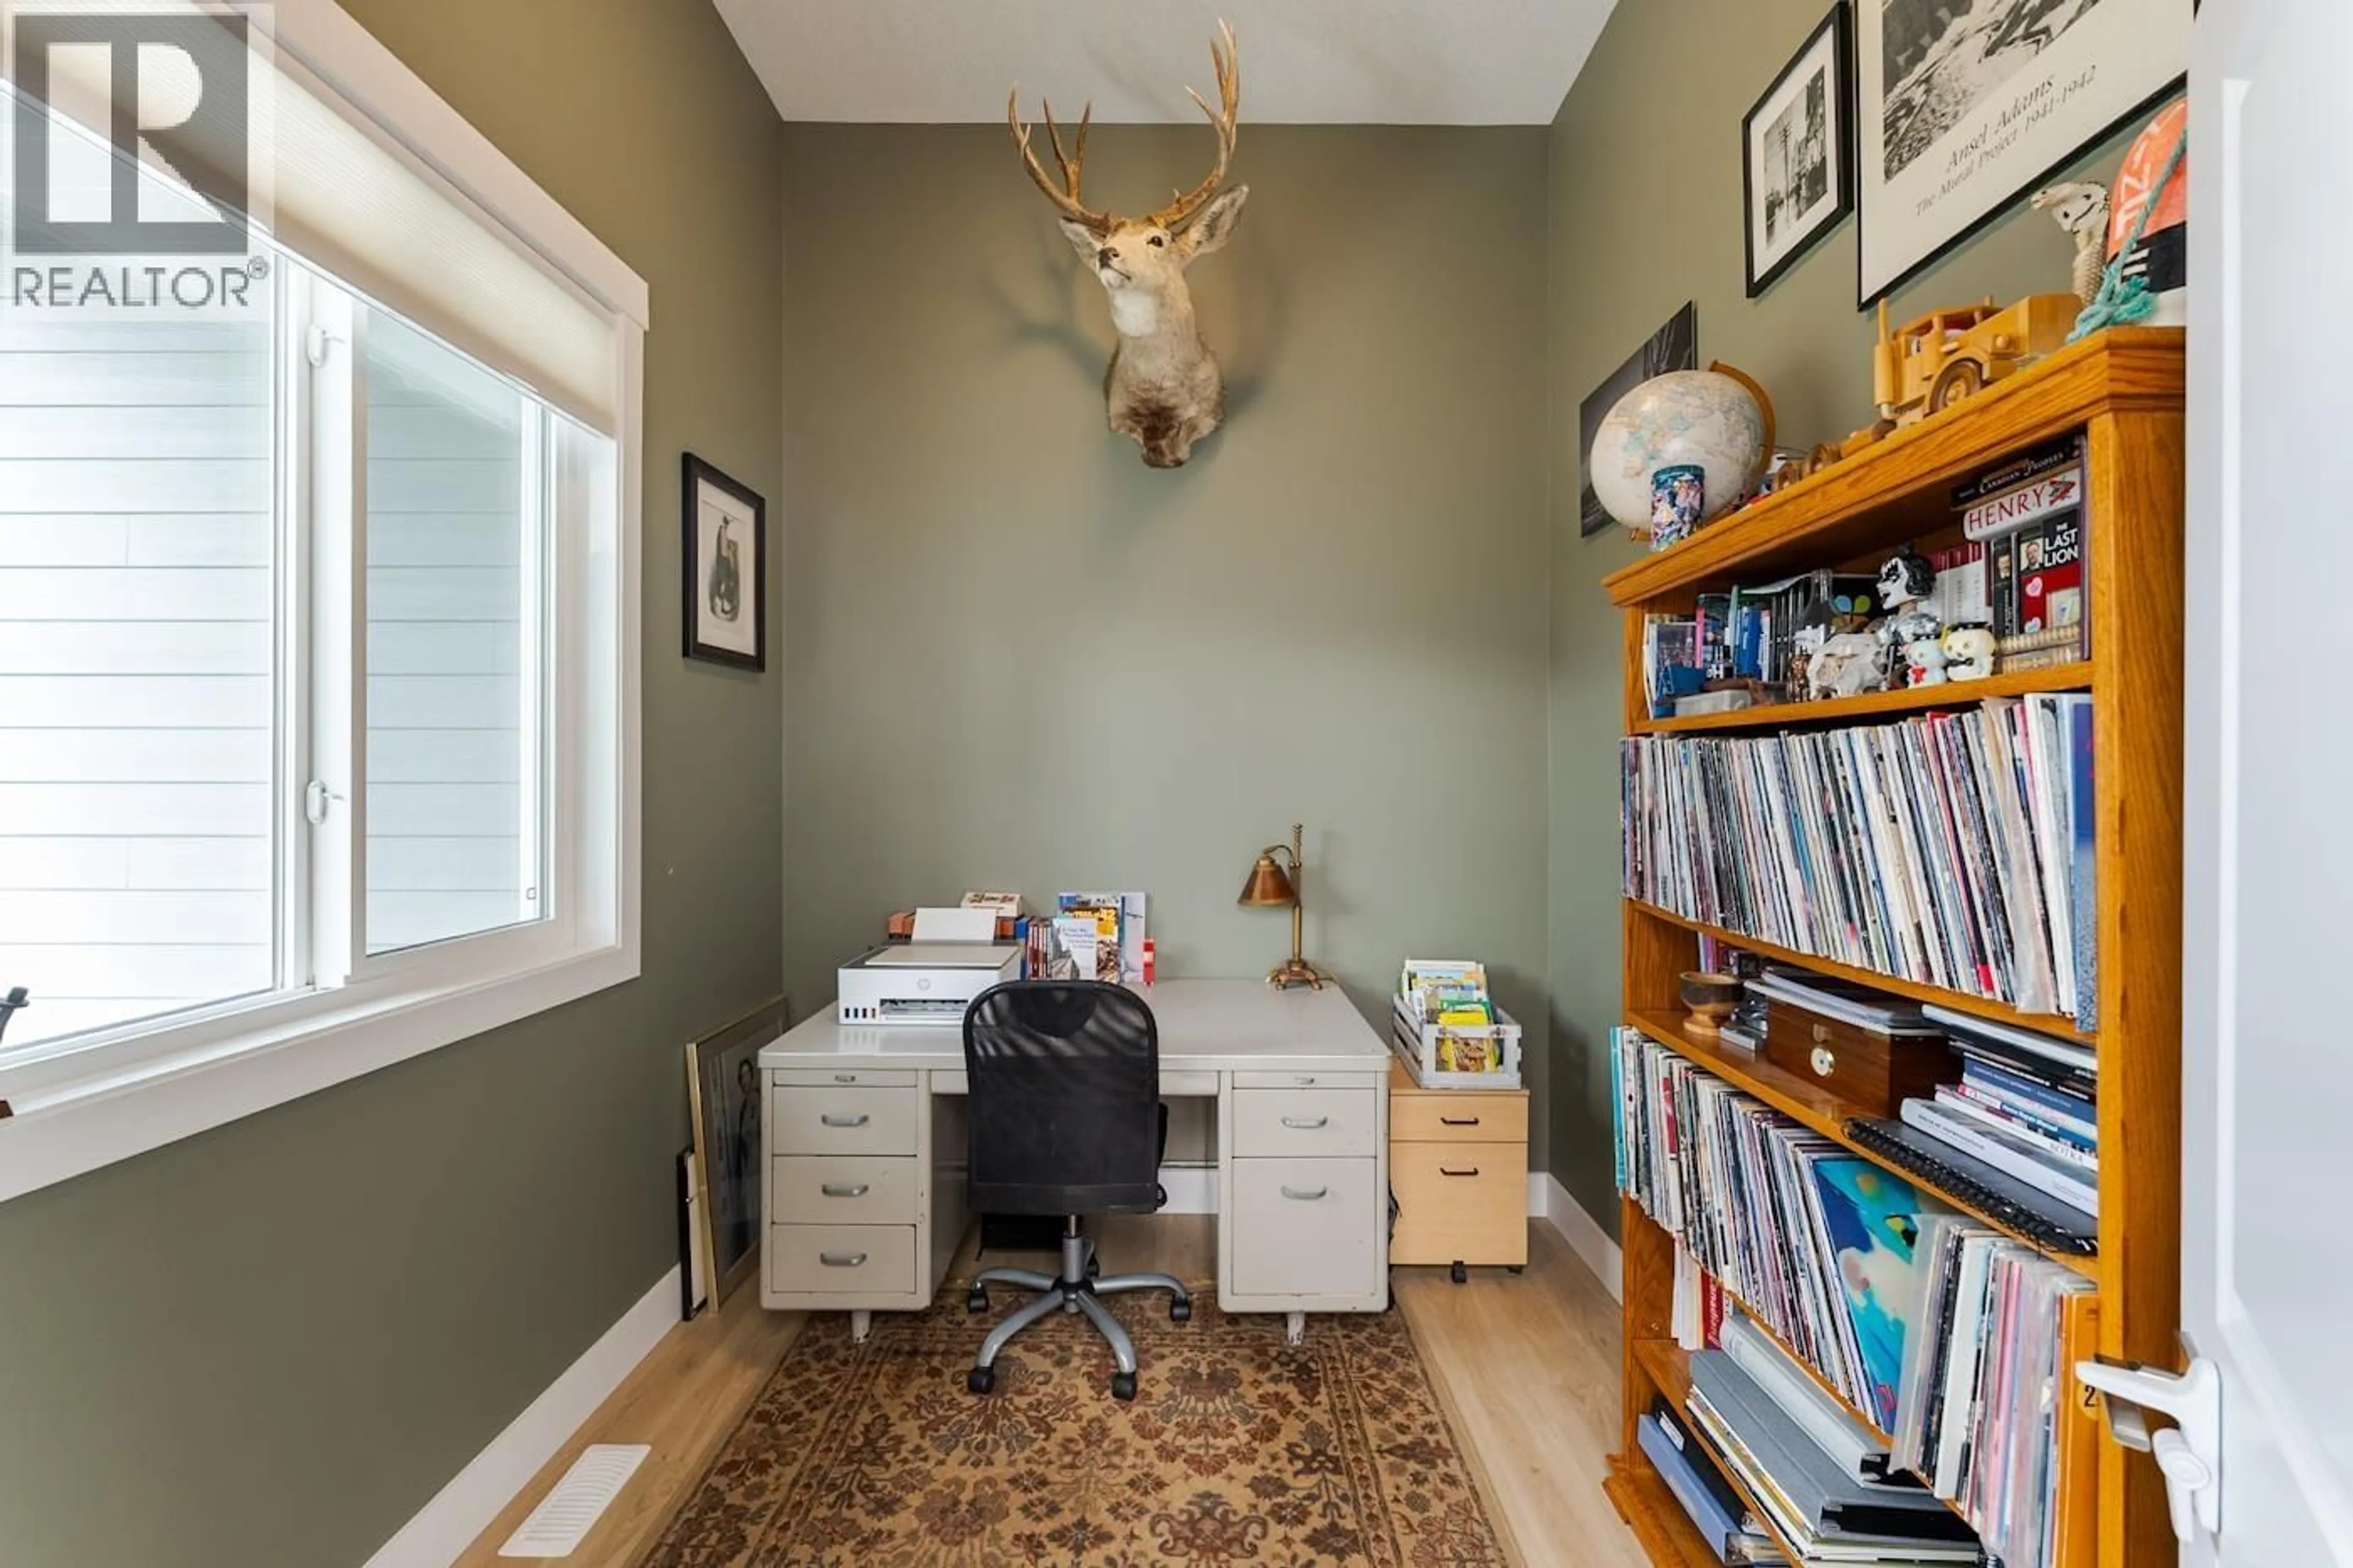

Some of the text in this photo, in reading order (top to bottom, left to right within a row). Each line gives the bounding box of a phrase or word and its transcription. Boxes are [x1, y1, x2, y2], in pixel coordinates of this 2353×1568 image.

[1947, 75, 2054, 172] Ansel Adams
[1979, 129, 2017, 168] Project
[1969, 485, 2046, 532] HENRY
[2045, 529, 2078, 551] LAST
[2045, 546, 2079, 567] LION
